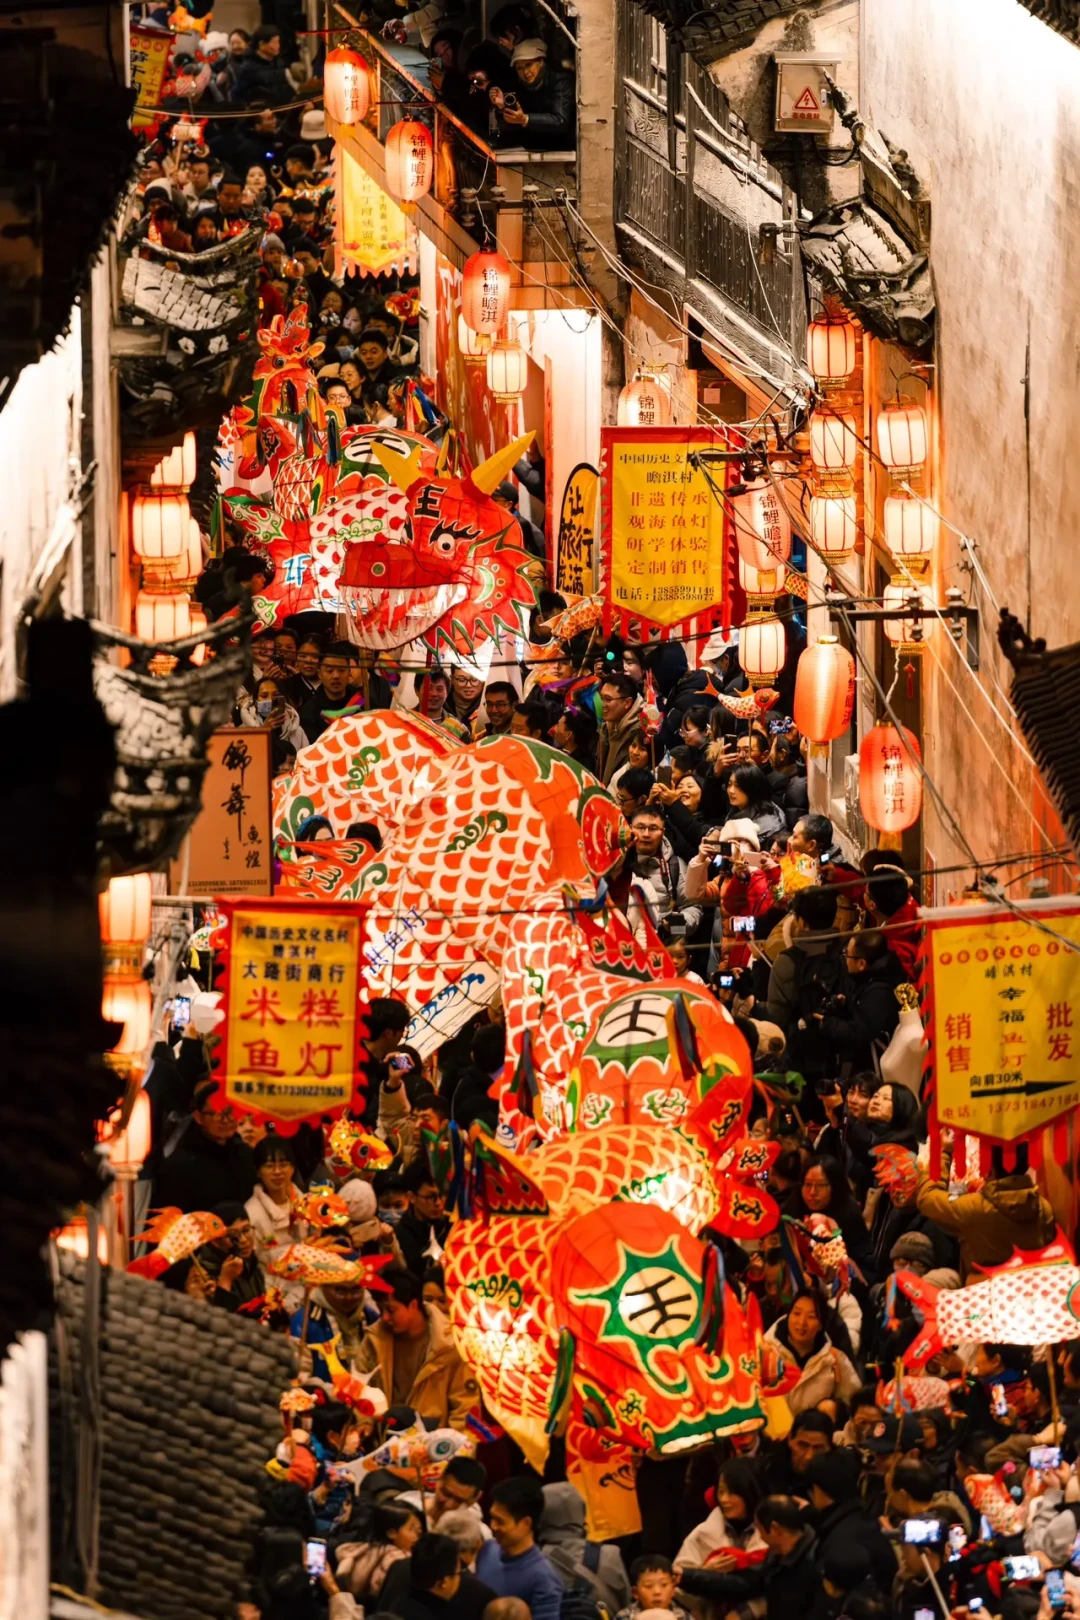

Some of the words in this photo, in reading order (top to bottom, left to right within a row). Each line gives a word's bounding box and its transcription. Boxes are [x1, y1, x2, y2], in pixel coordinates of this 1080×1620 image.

[410, 134, 427, 187] 锦鲤瞻淇
[481, 268, 499, 323] 锦鲤瞻淇
[619, 453, 721, 465] 中国历史文
[646, 471, 694, 484] 瞻淇村
[569, 485, 585, 517] 让
[631, 491, 709, 507] 非遗传承
[628, 514, 709, 530] 观海鱼灯
[759, 494, 783, 557] 锦鲤瞻淇
[626, 536, 709, 552] 研学体验
[627, 559, 709, 575] 定制销售
[881, 744, 905, 814] 锦鲤瞻淇
[238, 986, 346, 1028] 米糕
[944, 1013, 972, 1073] 销售
[1046, 1001, 1074, 1062] 批发
[237, 1038, 344, 1079] 鱼灯
